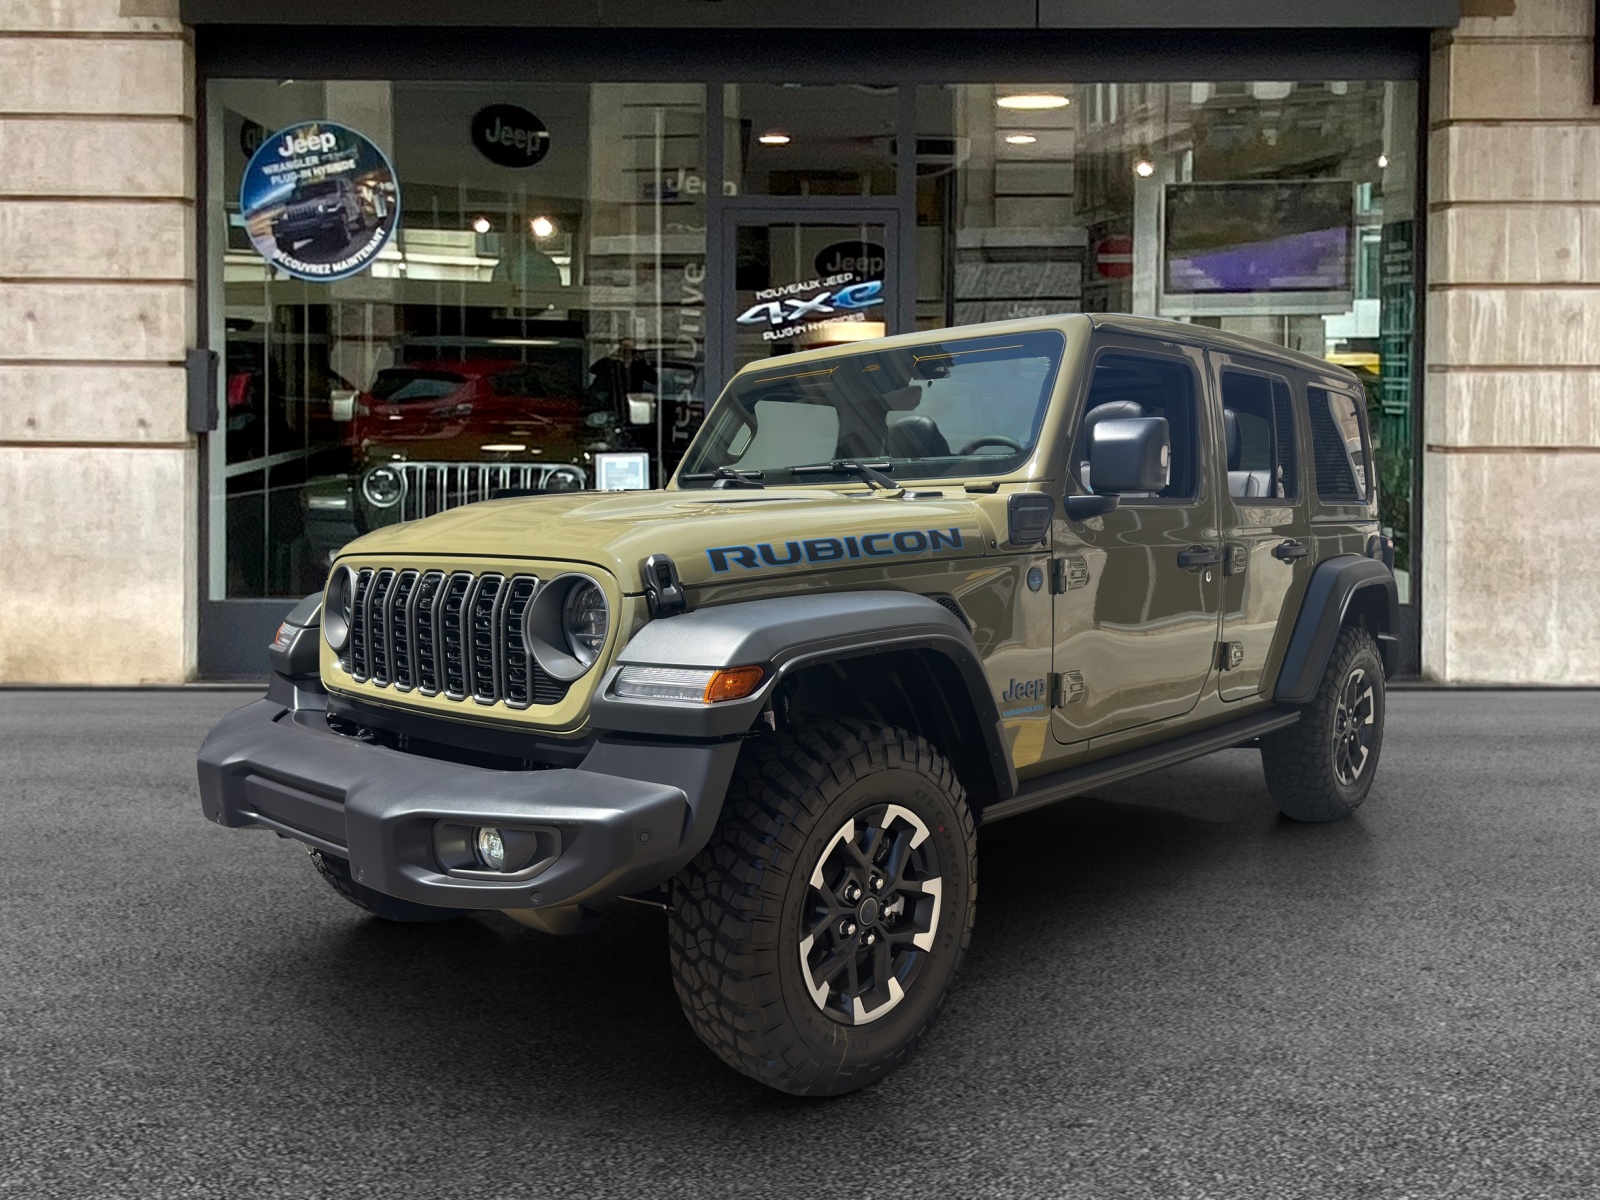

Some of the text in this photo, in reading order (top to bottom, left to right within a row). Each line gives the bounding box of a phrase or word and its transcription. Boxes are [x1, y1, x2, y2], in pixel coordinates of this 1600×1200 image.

[278, 132, 337, 158] Jeep
[486, 116, 541, 156] Jeep
[262, 155, 320, 176] WRANGLER
[270, 168, 313, 186] PLUG-IN
[331, 226, 386, 272] MAINTENANT
[825, 251, 884, 277] Jeep
[755, 272, 853, 300] NOUVEAUX JEEP
[705, 527, 964, 575] RUBICON
[1002, 677, 1046, 702] Jeep
[1002, 703, 1045, 718] WRANGLER
